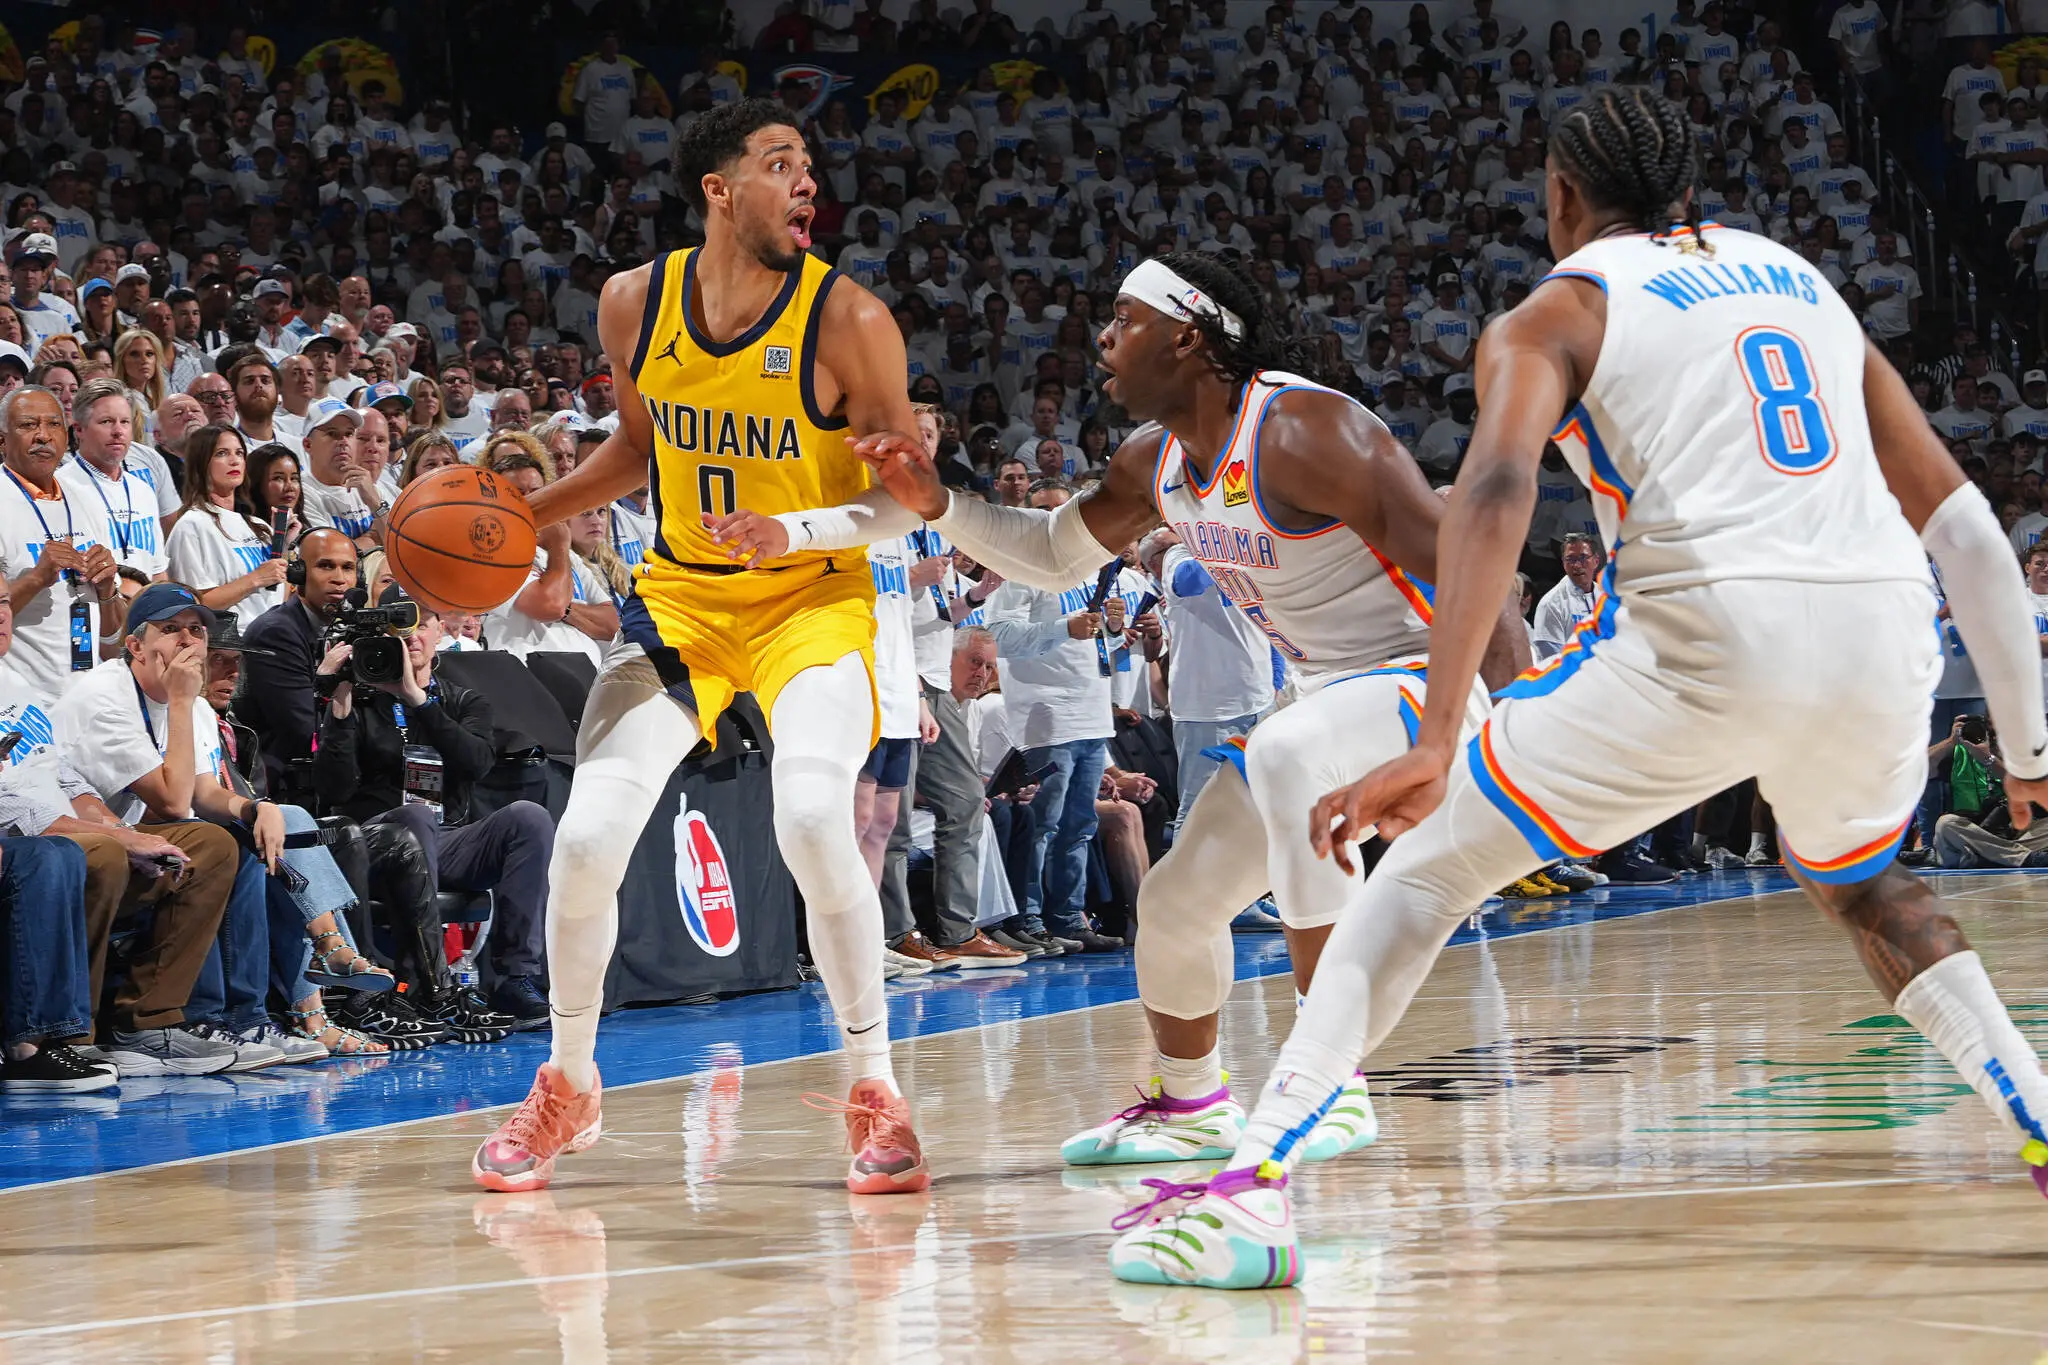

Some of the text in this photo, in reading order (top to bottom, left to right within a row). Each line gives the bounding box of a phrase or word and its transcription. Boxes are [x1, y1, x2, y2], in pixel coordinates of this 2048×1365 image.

[1642, 263, 1818, 311] WILLIAMS
[1734, 324, 1839, 477] 8
[698, 464, 737, 532] 0
[1175, 521, 1279, 570] LAHOMA
